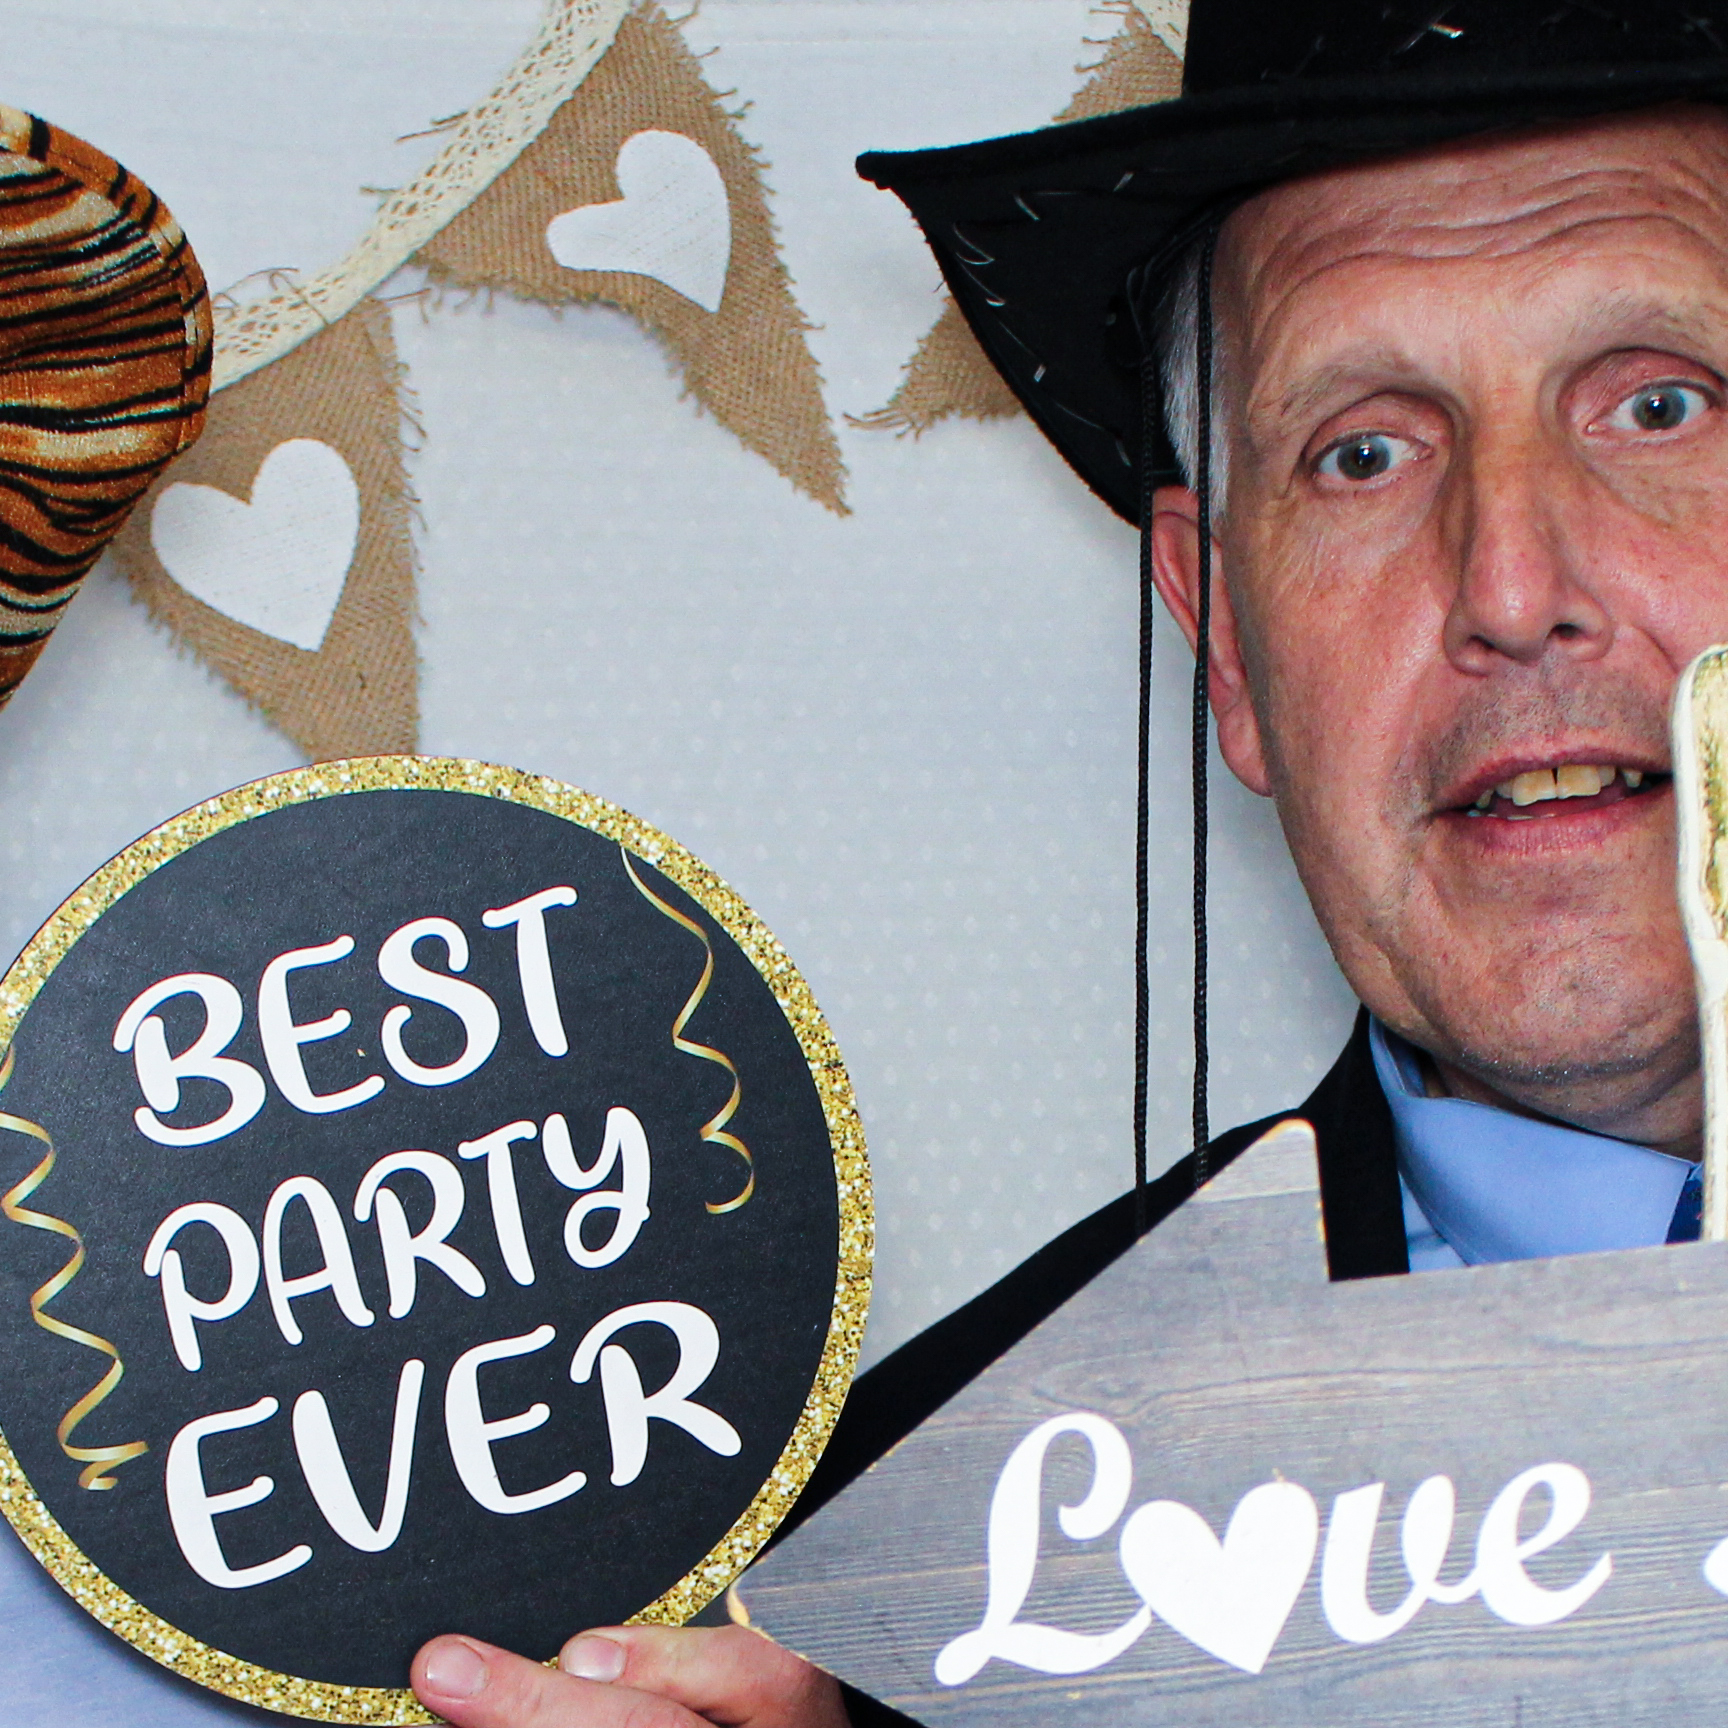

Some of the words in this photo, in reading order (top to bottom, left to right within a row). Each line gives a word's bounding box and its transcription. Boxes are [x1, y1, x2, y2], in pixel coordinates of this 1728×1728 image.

[113, 885, 577, 1146] BEST
[143, 1107, 651, 1372] PARTY
[165, 1301, 742, 1589] EVER
